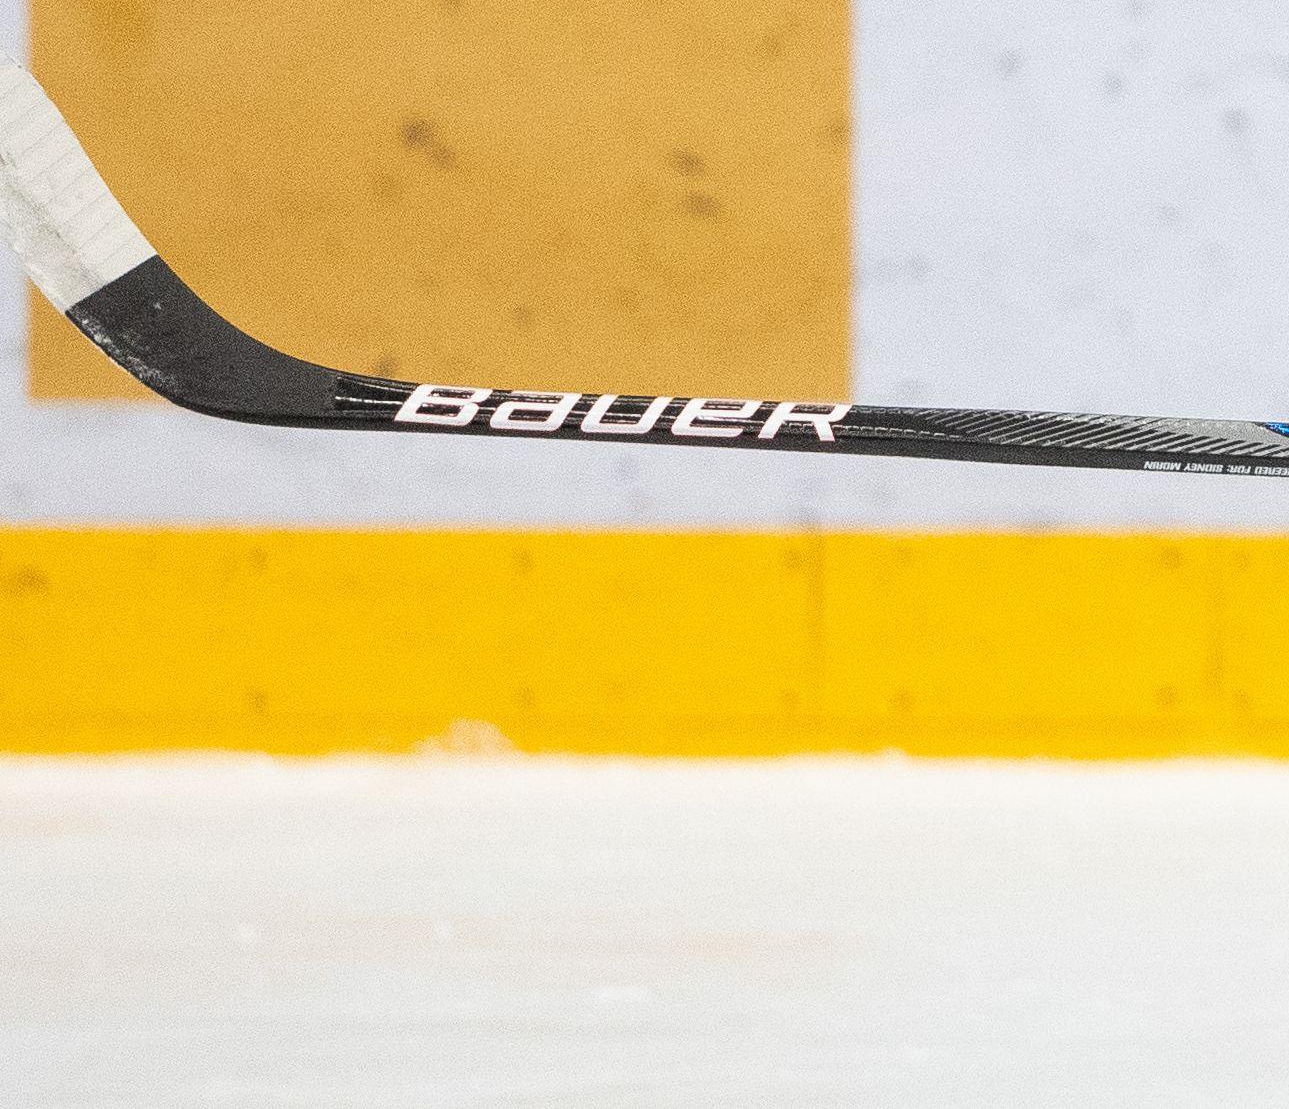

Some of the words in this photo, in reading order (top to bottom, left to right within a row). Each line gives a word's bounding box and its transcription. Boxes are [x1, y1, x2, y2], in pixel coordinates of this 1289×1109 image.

[394, 383, 854, 443] BAUER
[1143, 460, 1182, 472] MORIN
[1183, 462, 1224, 474] SIDNEY
